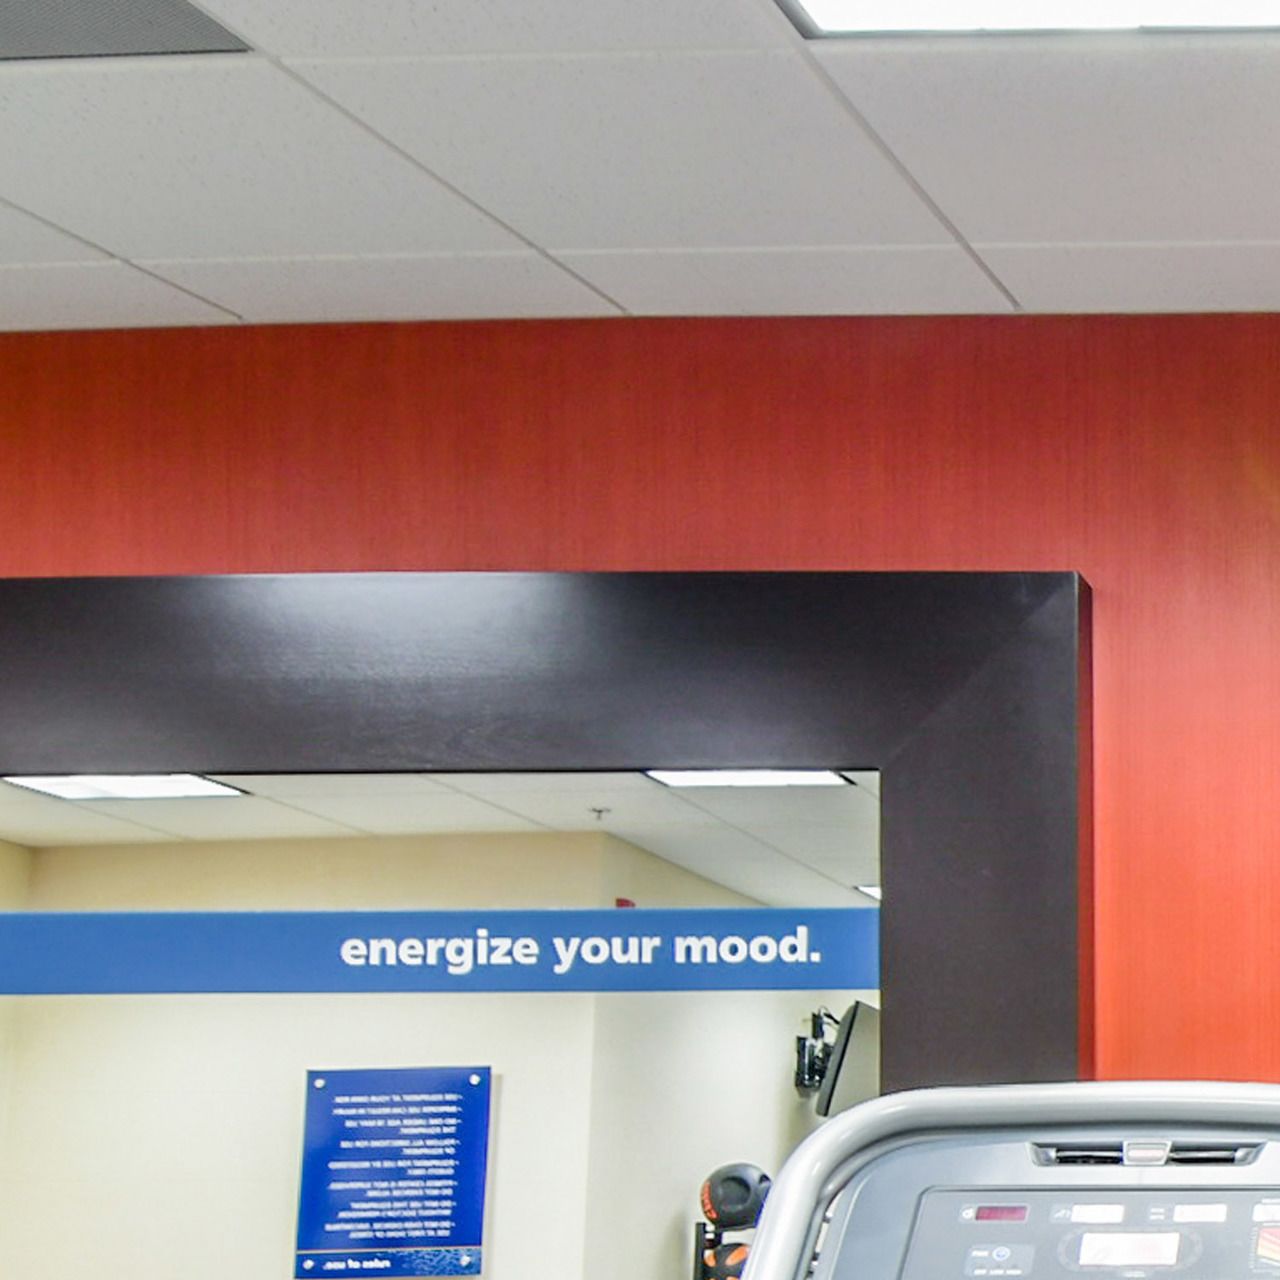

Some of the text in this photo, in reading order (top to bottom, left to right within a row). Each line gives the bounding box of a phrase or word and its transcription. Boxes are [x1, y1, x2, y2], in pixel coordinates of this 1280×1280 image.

[340, 925, 823, 975] energize your mood.
